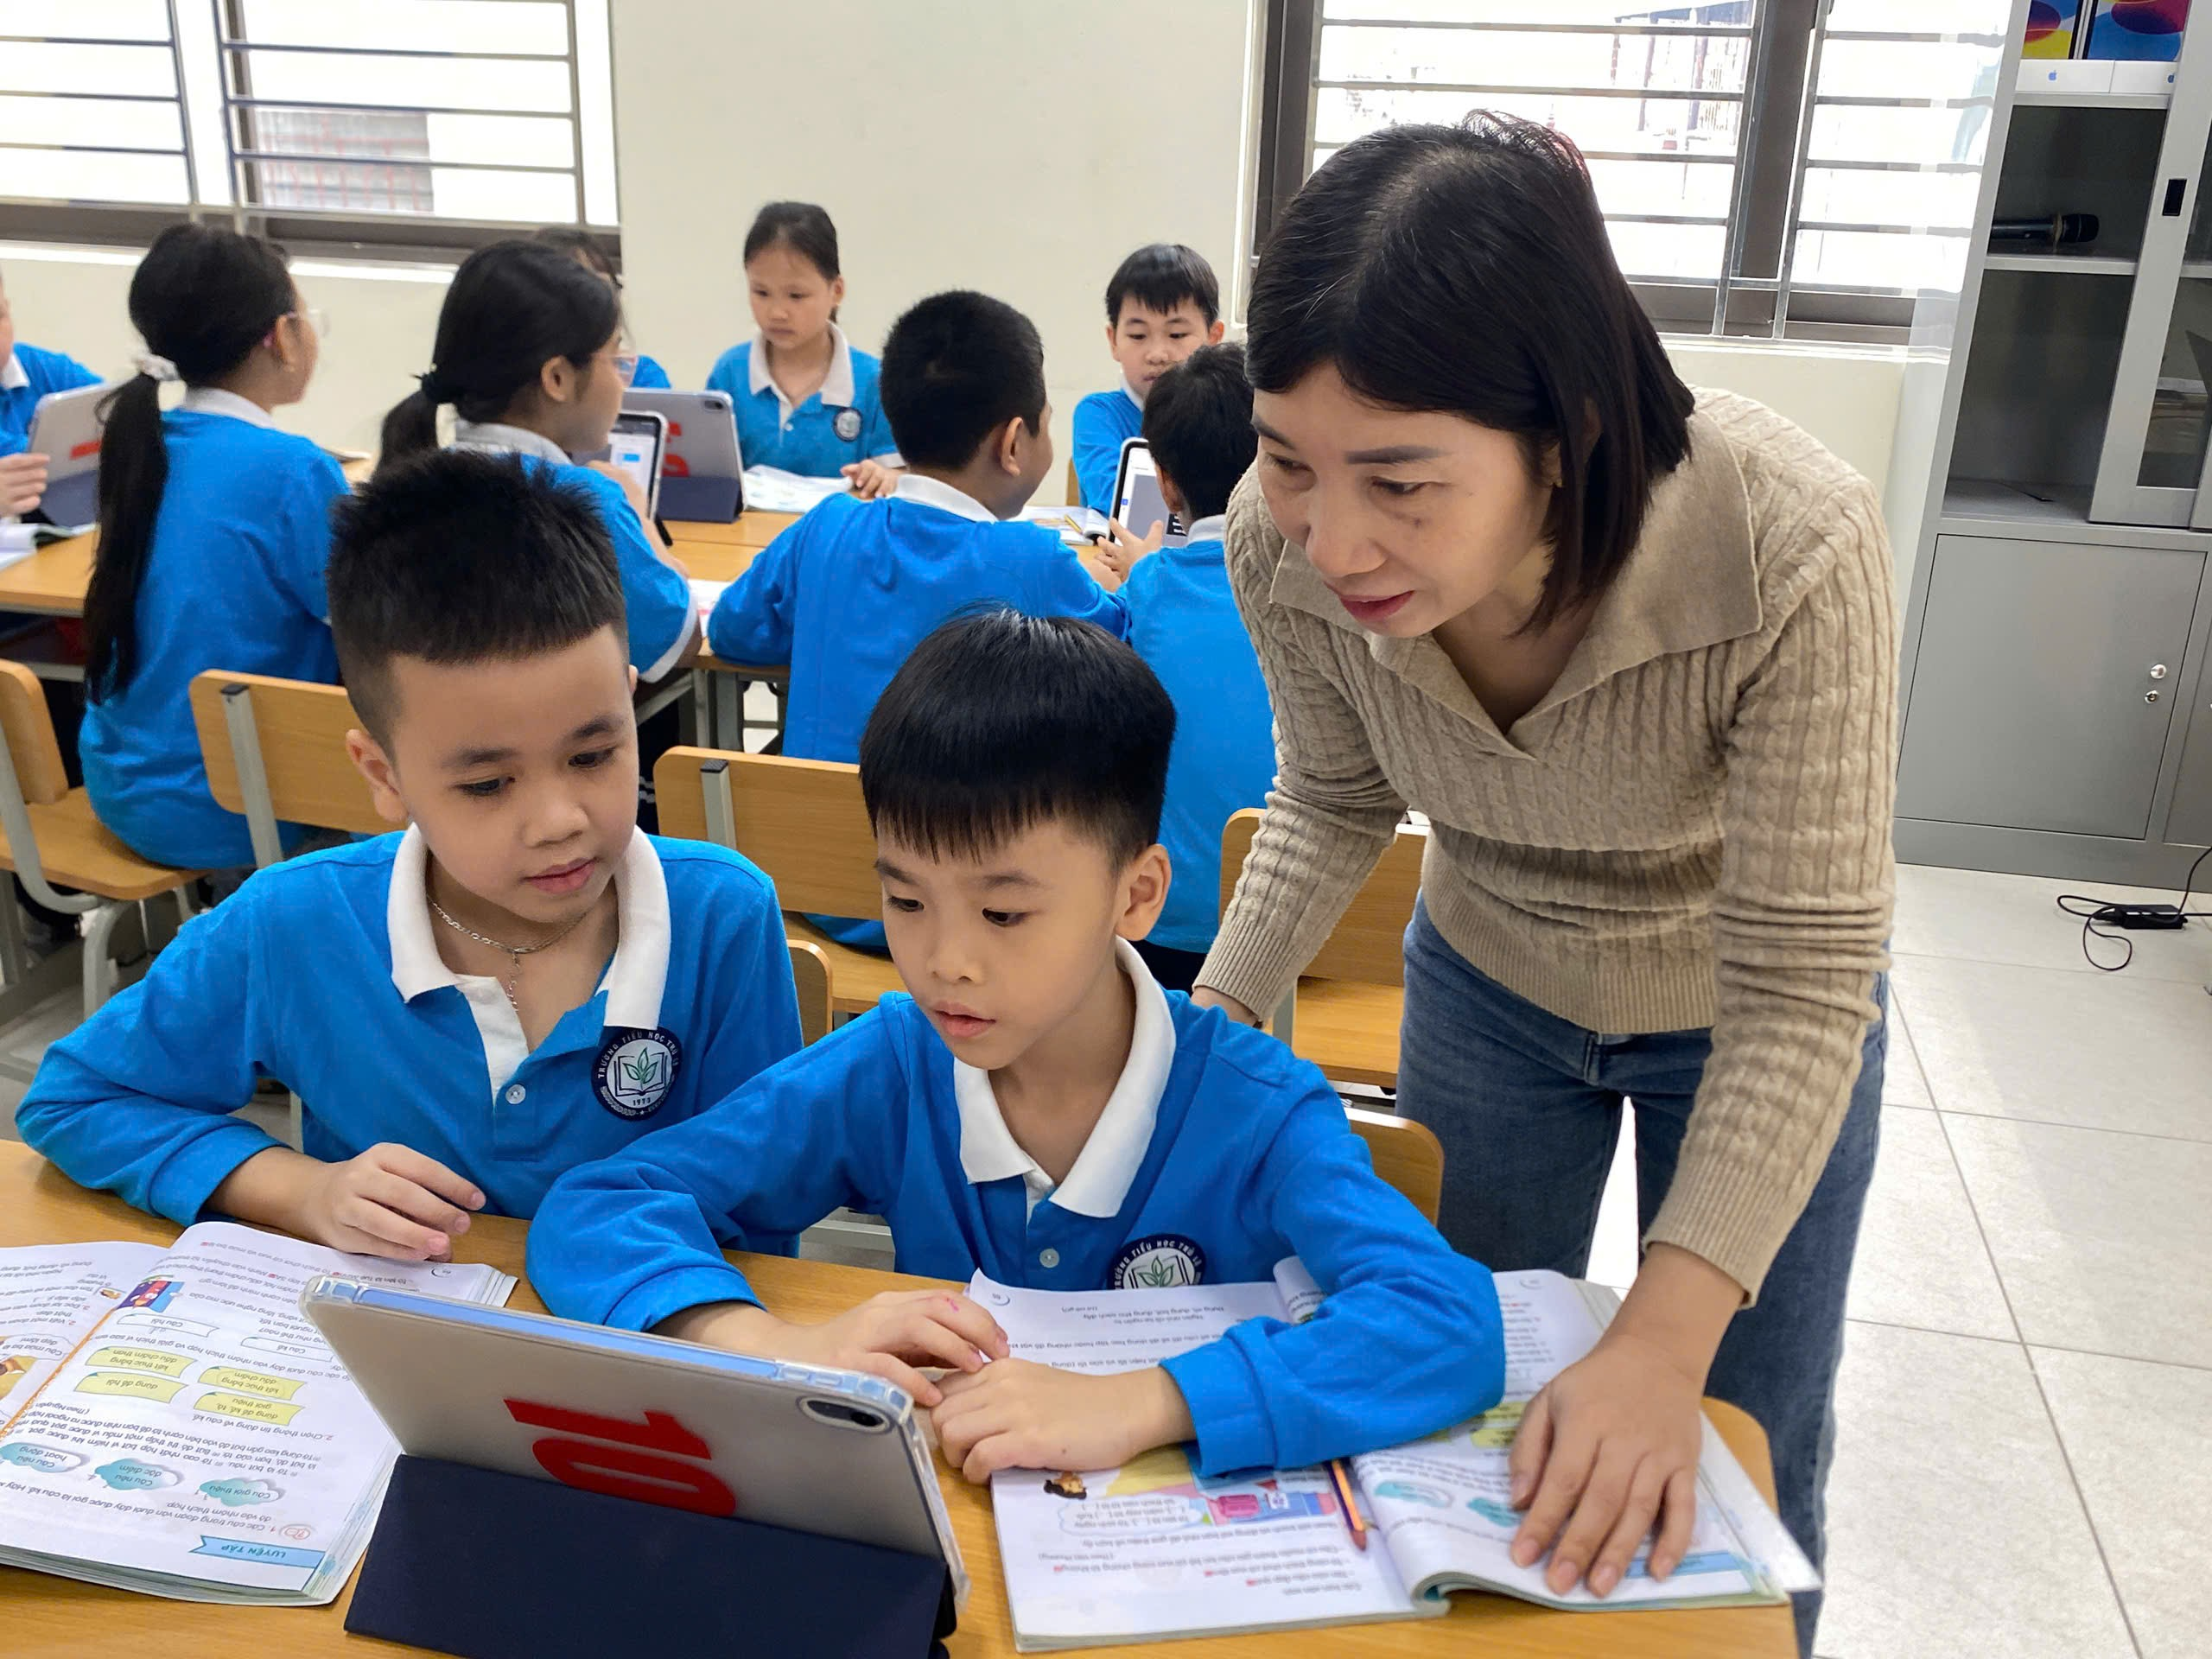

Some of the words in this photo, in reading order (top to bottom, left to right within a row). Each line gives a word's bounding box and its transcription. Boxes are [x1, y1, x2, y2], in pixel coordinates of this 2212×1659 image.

[648, 1032, 665, 1043] HỌC
[1156, 1240, 1176, 1249] HỌC
[236, 1303, 257, 1312] nghe
[272, 1320, 289, 1329] bạn
[187, 1344, 204, 1353] hợp
[205, 1349, 226, 1358] thích
[109, 1356, 133, 1365] bằng
[226, 1354, 251, 1363] nhóm
[269, 1363, 285, 1371] đây
[233, 1372, 258, 1381] chấm
[135, 1380, 158, 1389] dùng
[220, 1376, 244, 1387] bằng
[232, 1398, 254, 1407] thiệu
[255, 1410, 278, 1420] dùng
[79, 1419, 103, 1427] được
[235, 1421, 258, 1431] đúng
[68, 1426, 91, 1434] được
[162, 1430, 184, 1439] cạnh
[272, 1427, 298, 1437] thông
[46, 1430, 69, 1440] được
[186, 1435, 202, 1444] bên
[86, 1439, 110, 1447] hiếm
[145, 1435, 165, 1445] thấp
[139, 1444, 157, 1453] hộp
[194, 1446, 211, 1455] Bút
[43, 1451, 67, 1461] hoạt
[159, 1449, 181, 1458] nhất
[280, 1449, 302, 1459] dùng
[503, 1398, 736, 1517] 10
[36, 1459, 54, 1468] Câu
[118, 1465, 143, 1473] điểm
[5, 1481, 26, 1491] Hãy
[134, 1477, 153, 1486] Câu
[251, 1491, 270, 1499] Câu
[89, 1499, 112, 1508] được
[114, 1503, 132, 1511] đây
[187, 1505, 210, 1514] thích
[211, 1509, 239, 1517] nhóm
[175, 1513, 199, 1522] đoạn
[200, 1515, 225, 1525] trong
[246, 1522, 265, 1531] Các
[220, 1544, 244, 1553] TẬP
[247, 1548, 286, 1558] LUYỆN
